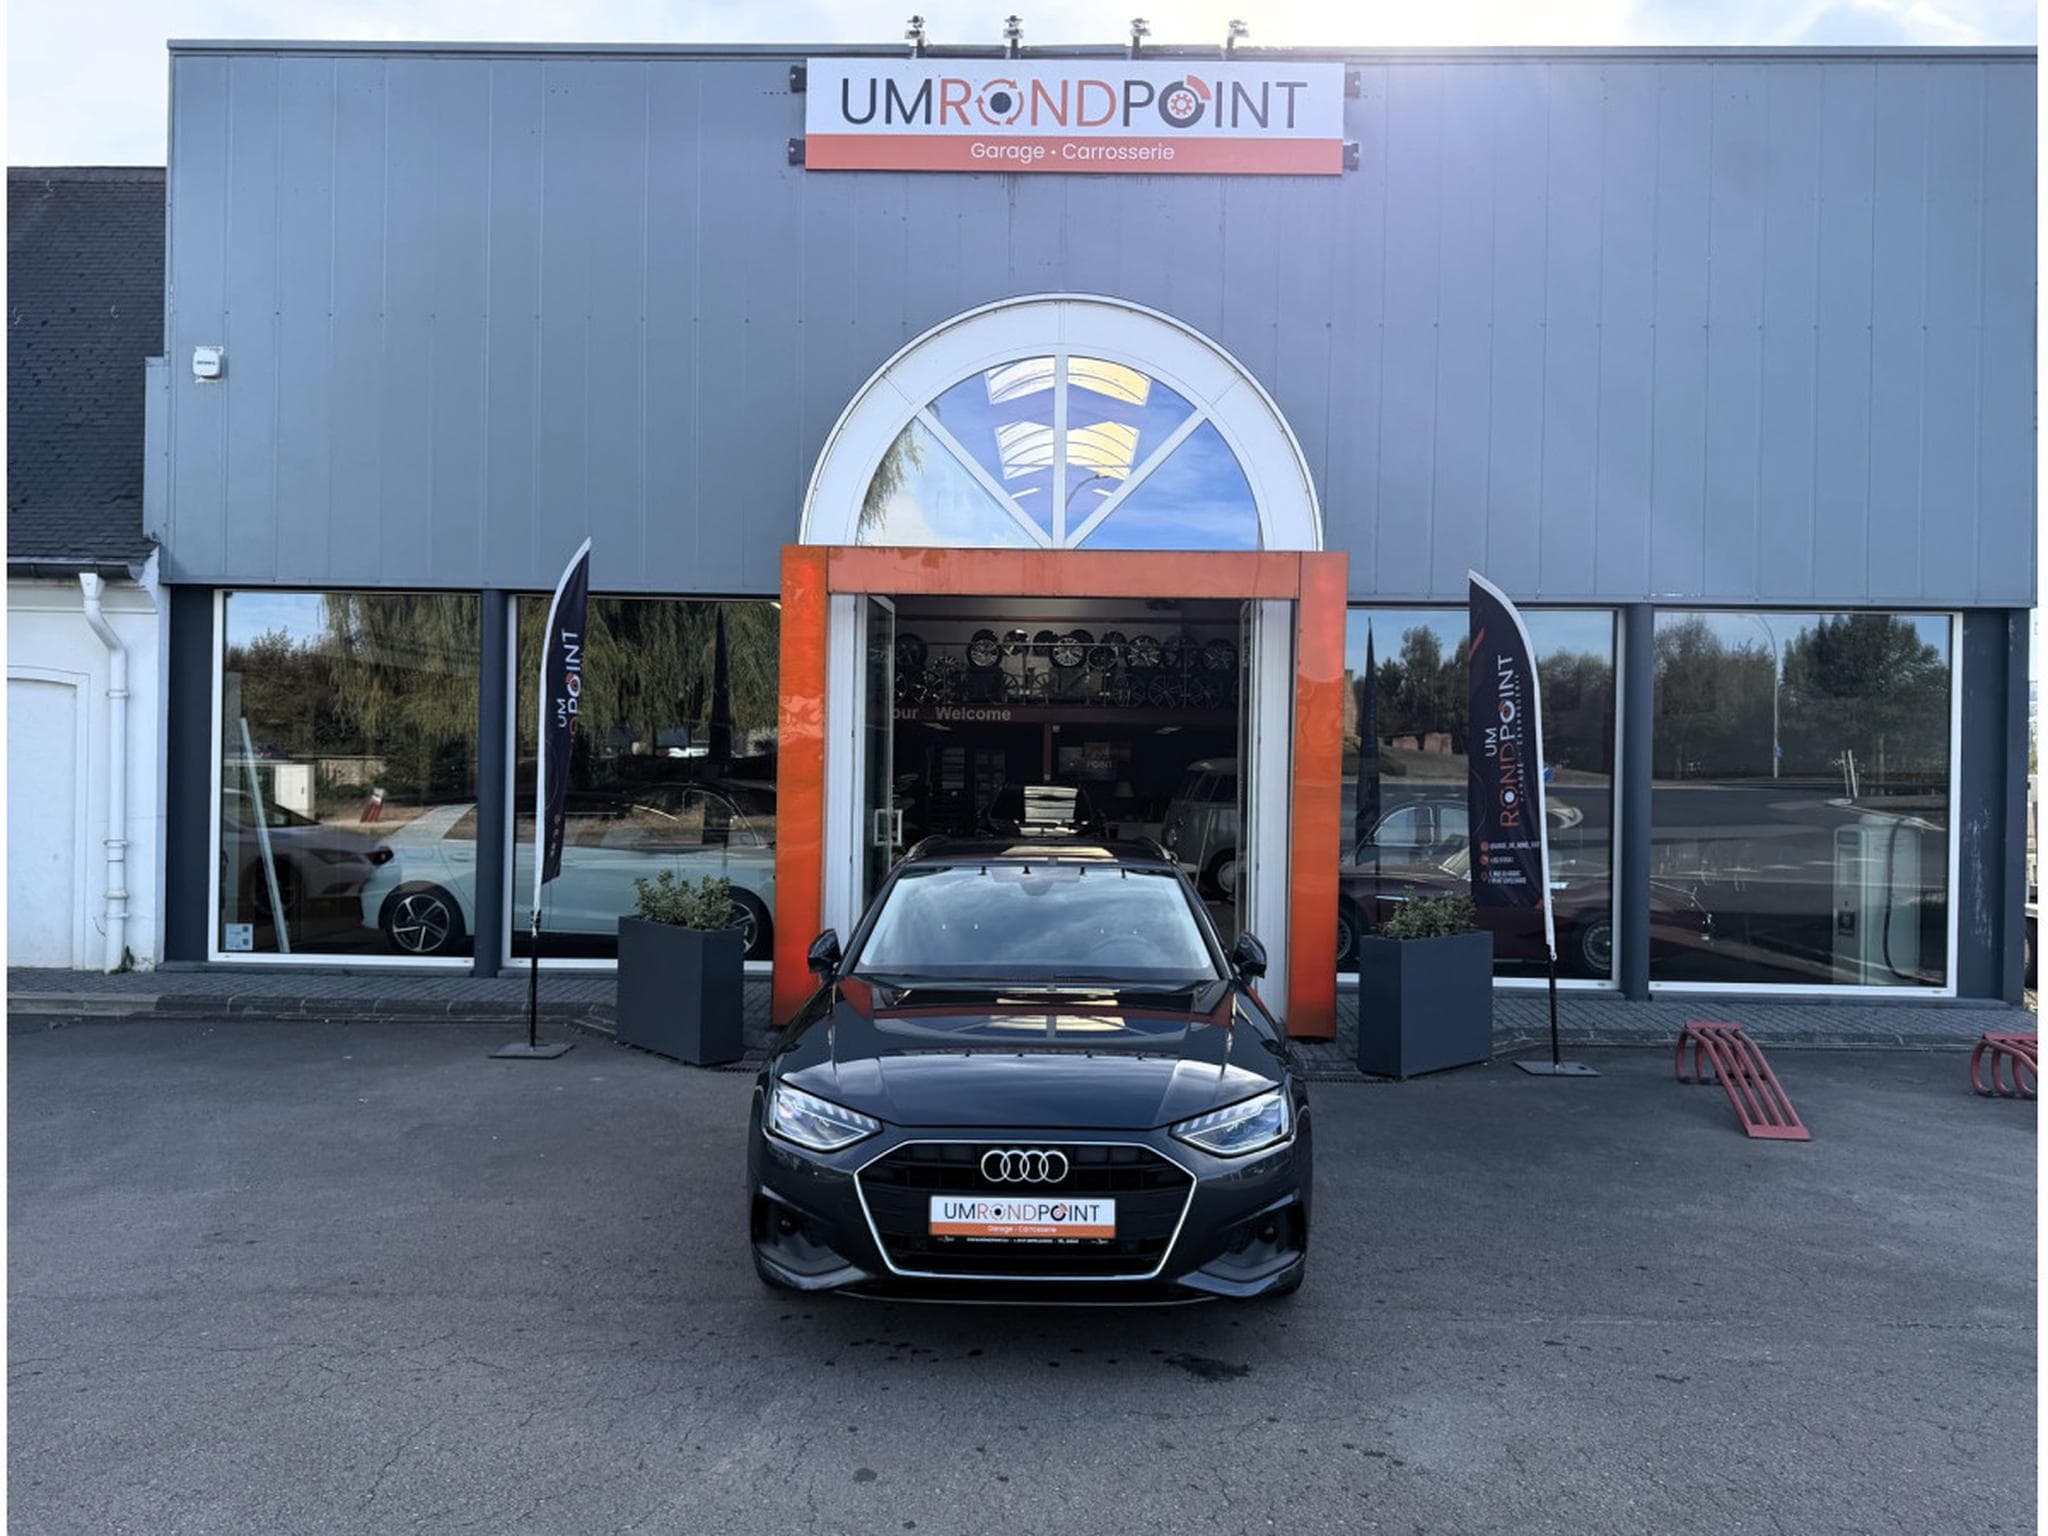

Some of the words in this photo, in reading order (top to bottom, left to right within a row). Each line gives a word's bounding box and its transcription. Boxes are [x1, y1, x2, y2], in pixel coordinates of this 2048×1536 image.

[970, 142, 1046, 163] Garage
[1062, 142, 1175, 161] Carrosserie
[556, 698, 567, 728] UM
[935, 706, 1011, 721] Welcome
[1485, 727, 1498, 758] UM
